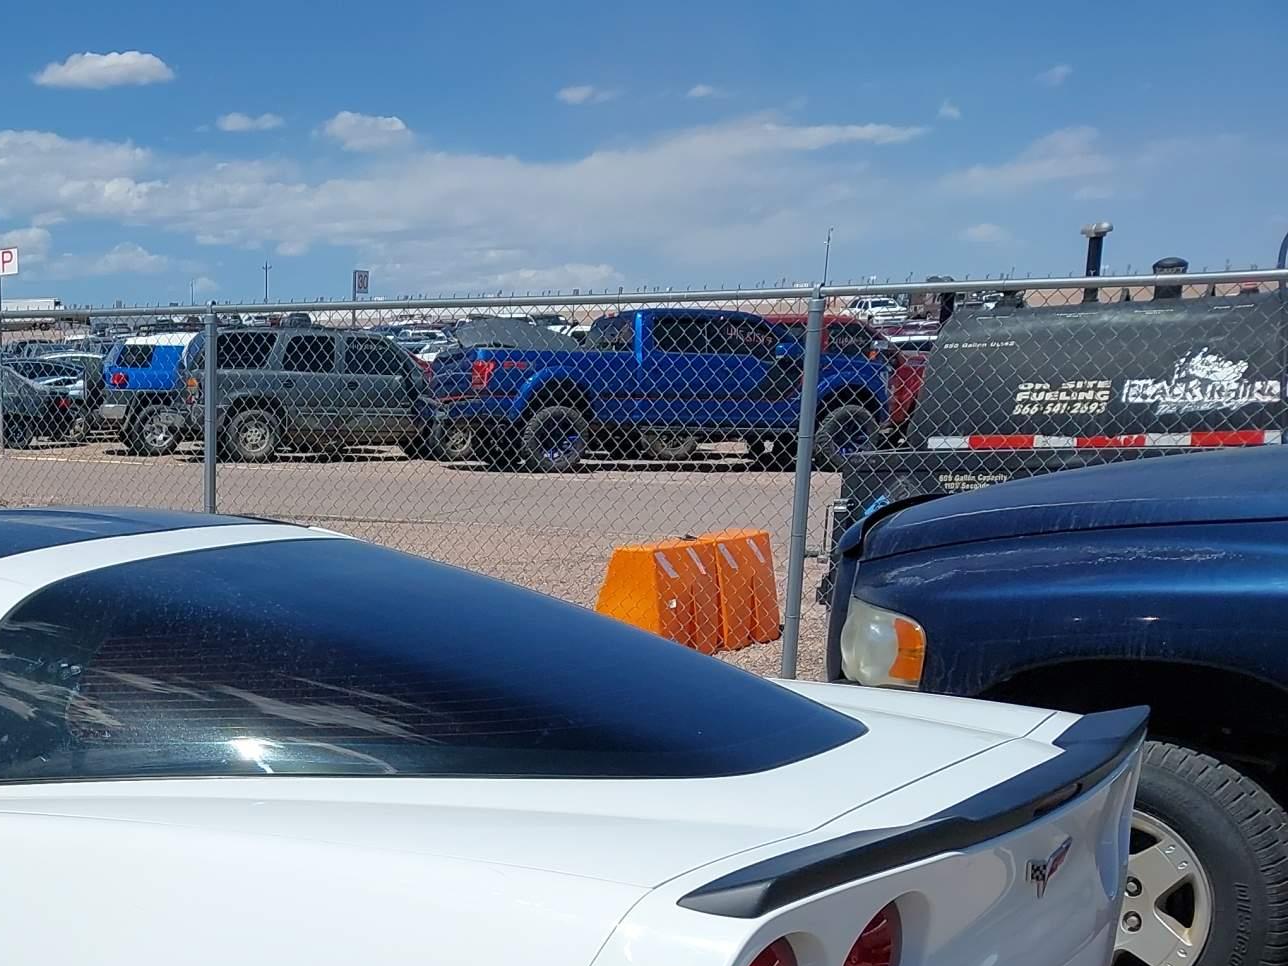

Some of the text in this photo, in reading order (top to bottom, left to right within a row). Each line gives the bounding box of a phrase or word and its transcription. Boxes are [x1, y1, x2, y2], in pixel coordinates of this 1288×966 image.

[1062, 379, 1112, 389] SITE
[1015, 390, 1110, 402] FUELING
[954, 474, 976, 482] Gallon
[977, 473, 1008, 482] Capacity
